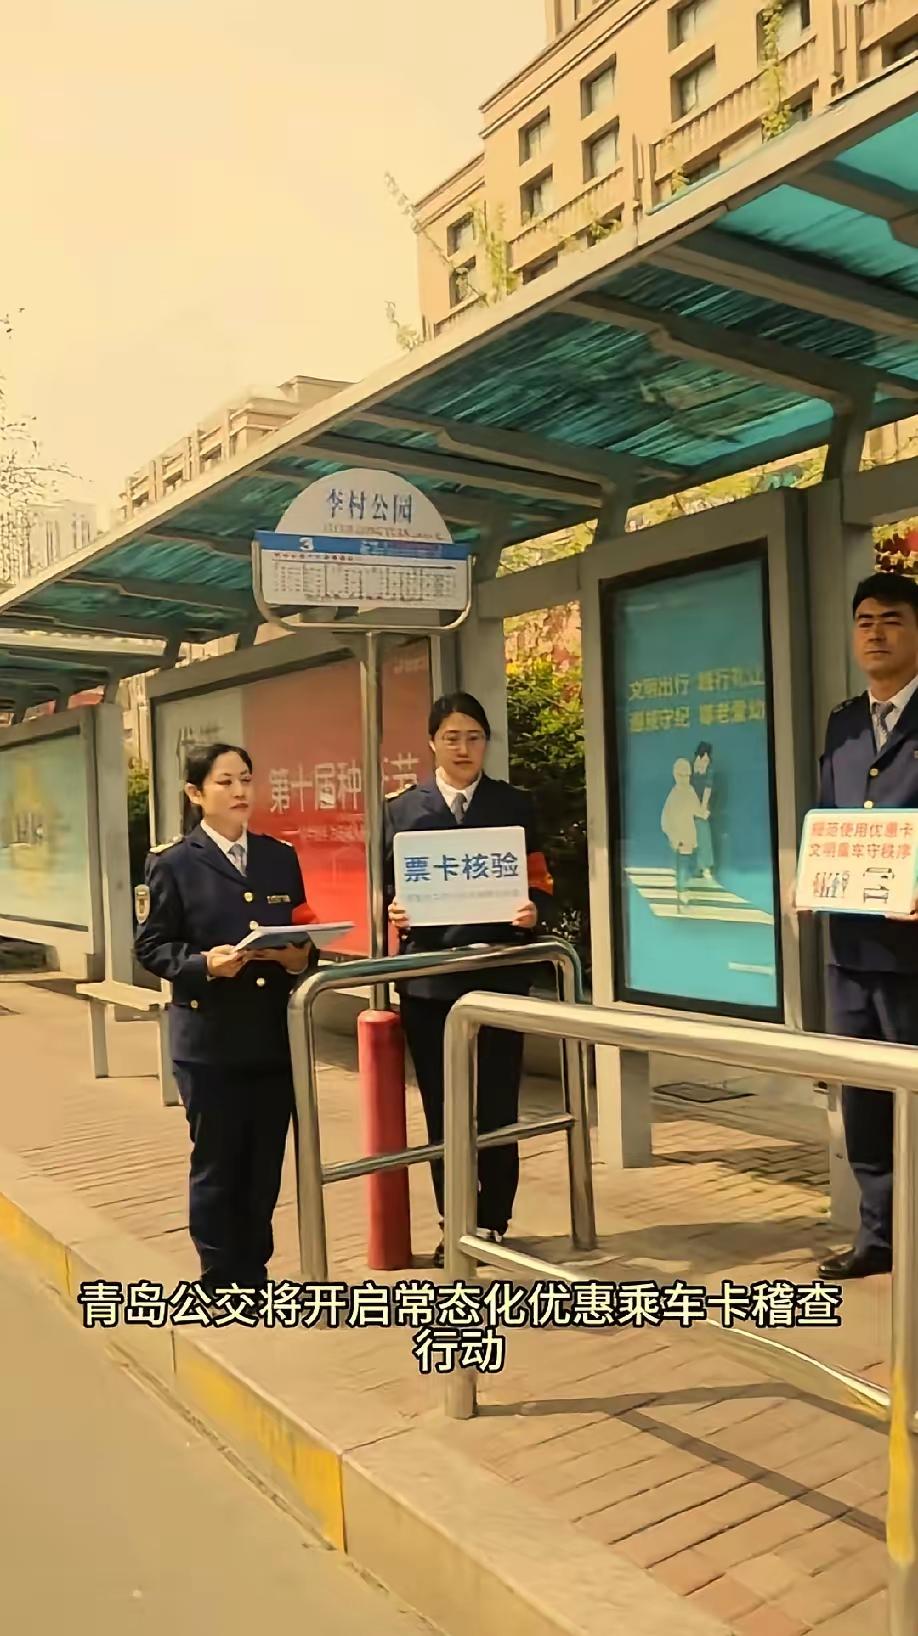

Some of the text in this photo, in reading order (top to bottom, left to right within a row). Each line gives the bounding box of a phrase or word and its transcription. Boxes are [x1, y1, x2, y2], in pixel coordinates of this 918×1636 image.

[299, 537, 315, 551] 3
[403, 851, 520, 882] 票卡核验
